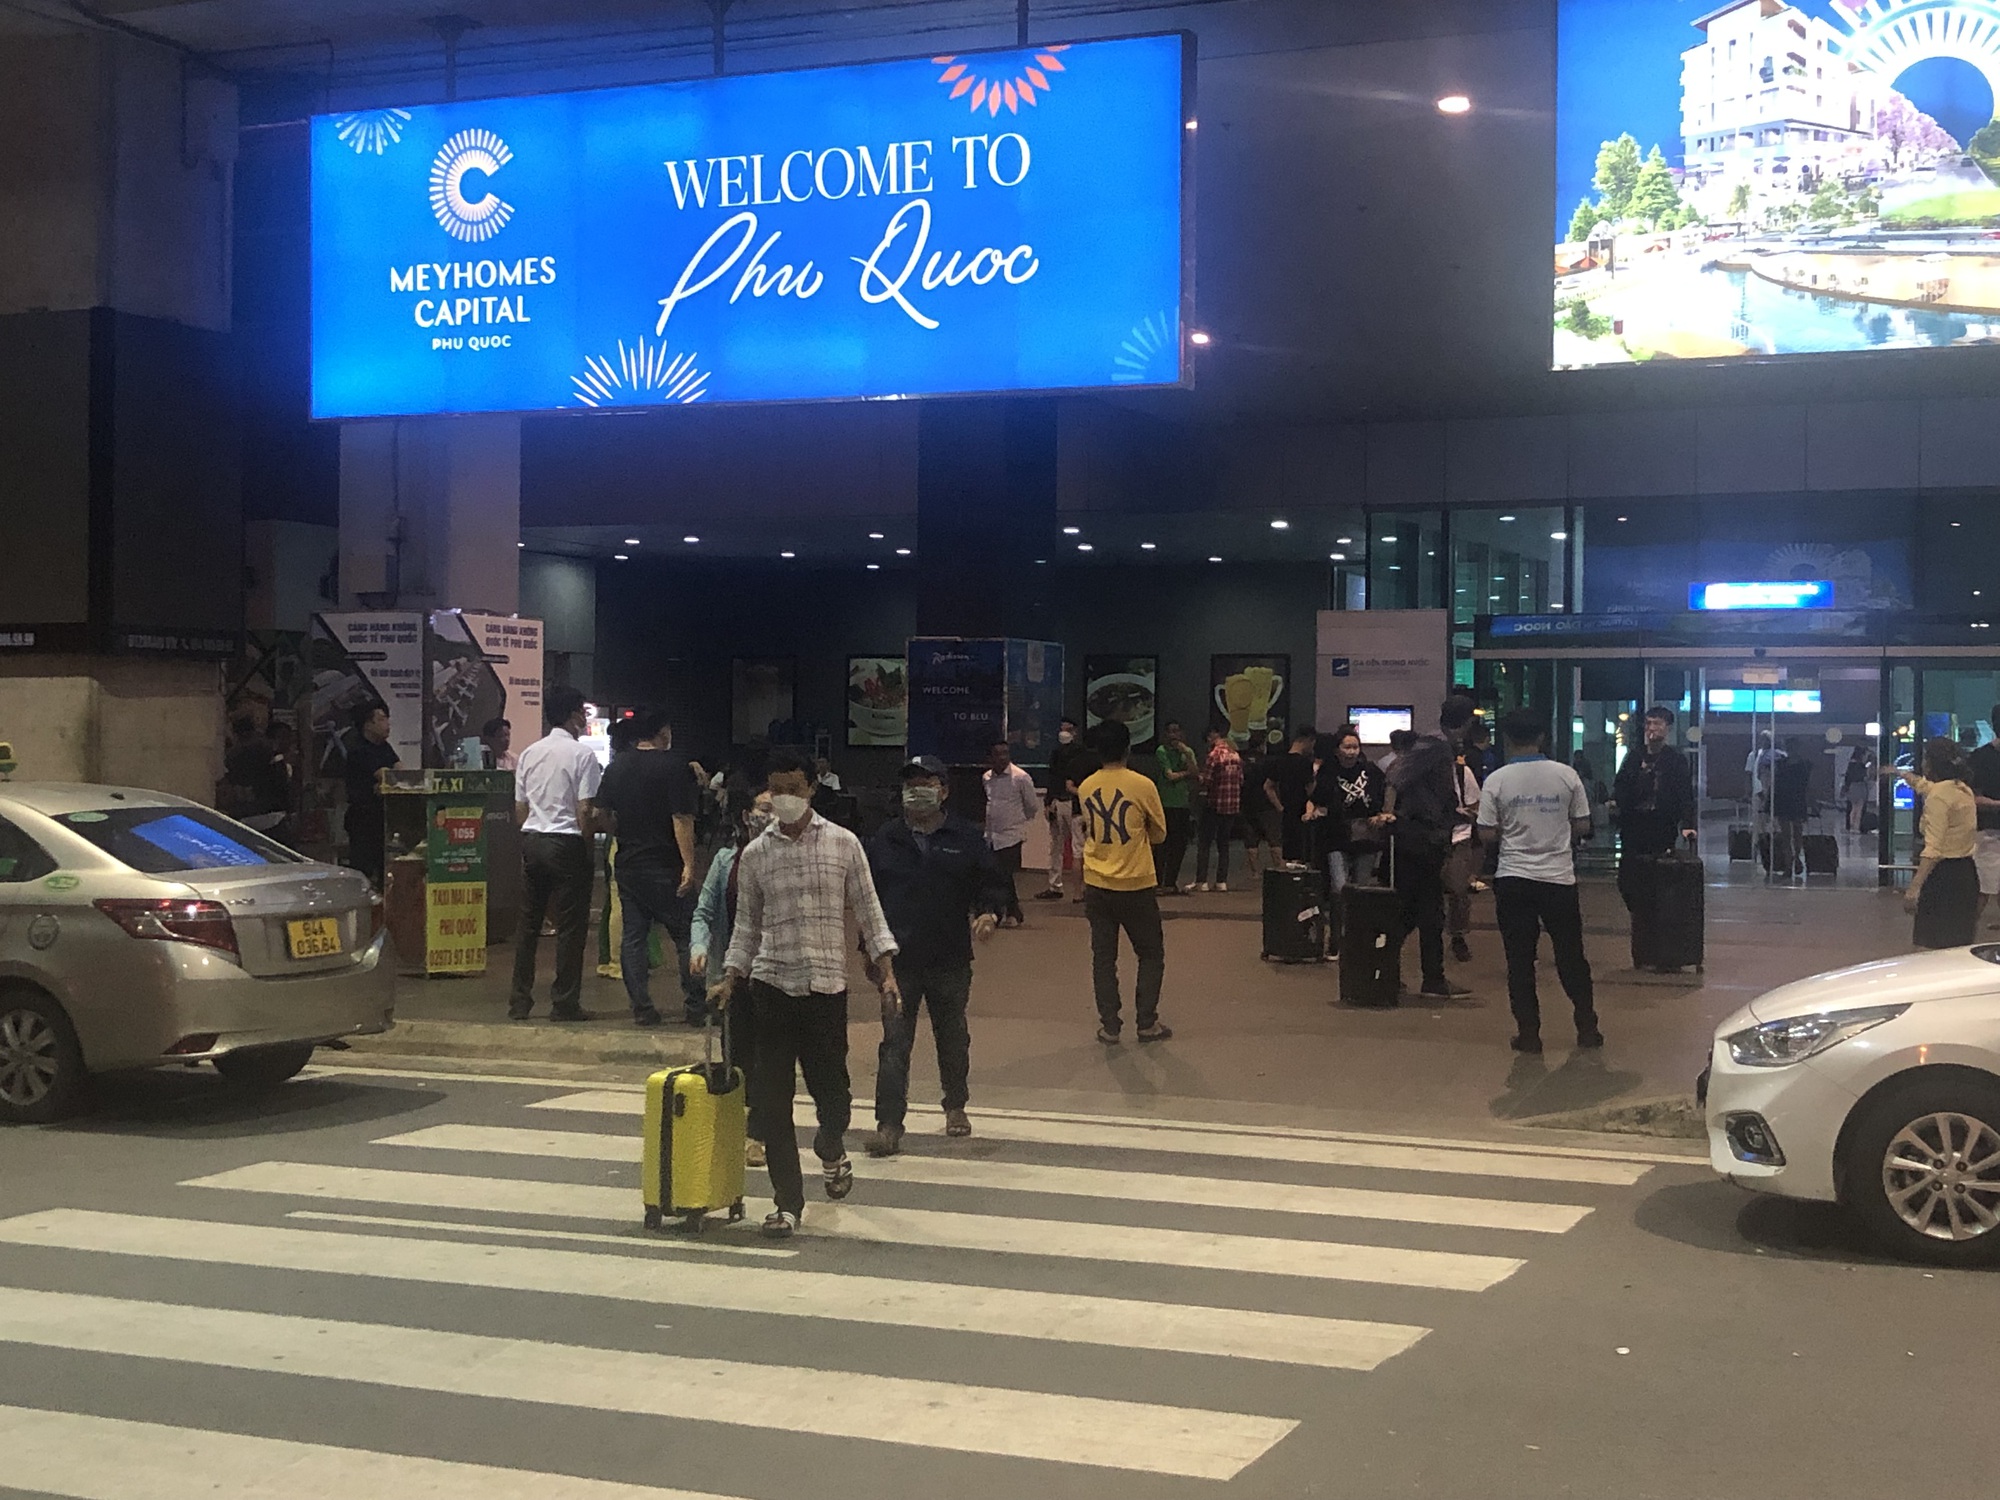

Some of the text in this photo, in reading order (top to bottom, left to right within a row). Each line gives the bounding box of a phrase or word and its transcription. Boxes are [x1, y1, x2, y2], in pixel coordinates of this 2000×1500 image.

[663, 132, 1031, 210] WELCOME TO
[389, 255, 557, 294] MEYHOMES
[655, 197, 1040, 337] Phu Quoc
[413, 294, 532, 329] CAPITAL
[431, 334, 512, 352] PHU QUOC
[922, 686, 970, 695] WELCOME
[952, 712, 989, 721] TO BLU
[432, 777, 464, 793] TAXI
[452, 827, 475, 839] 1055
